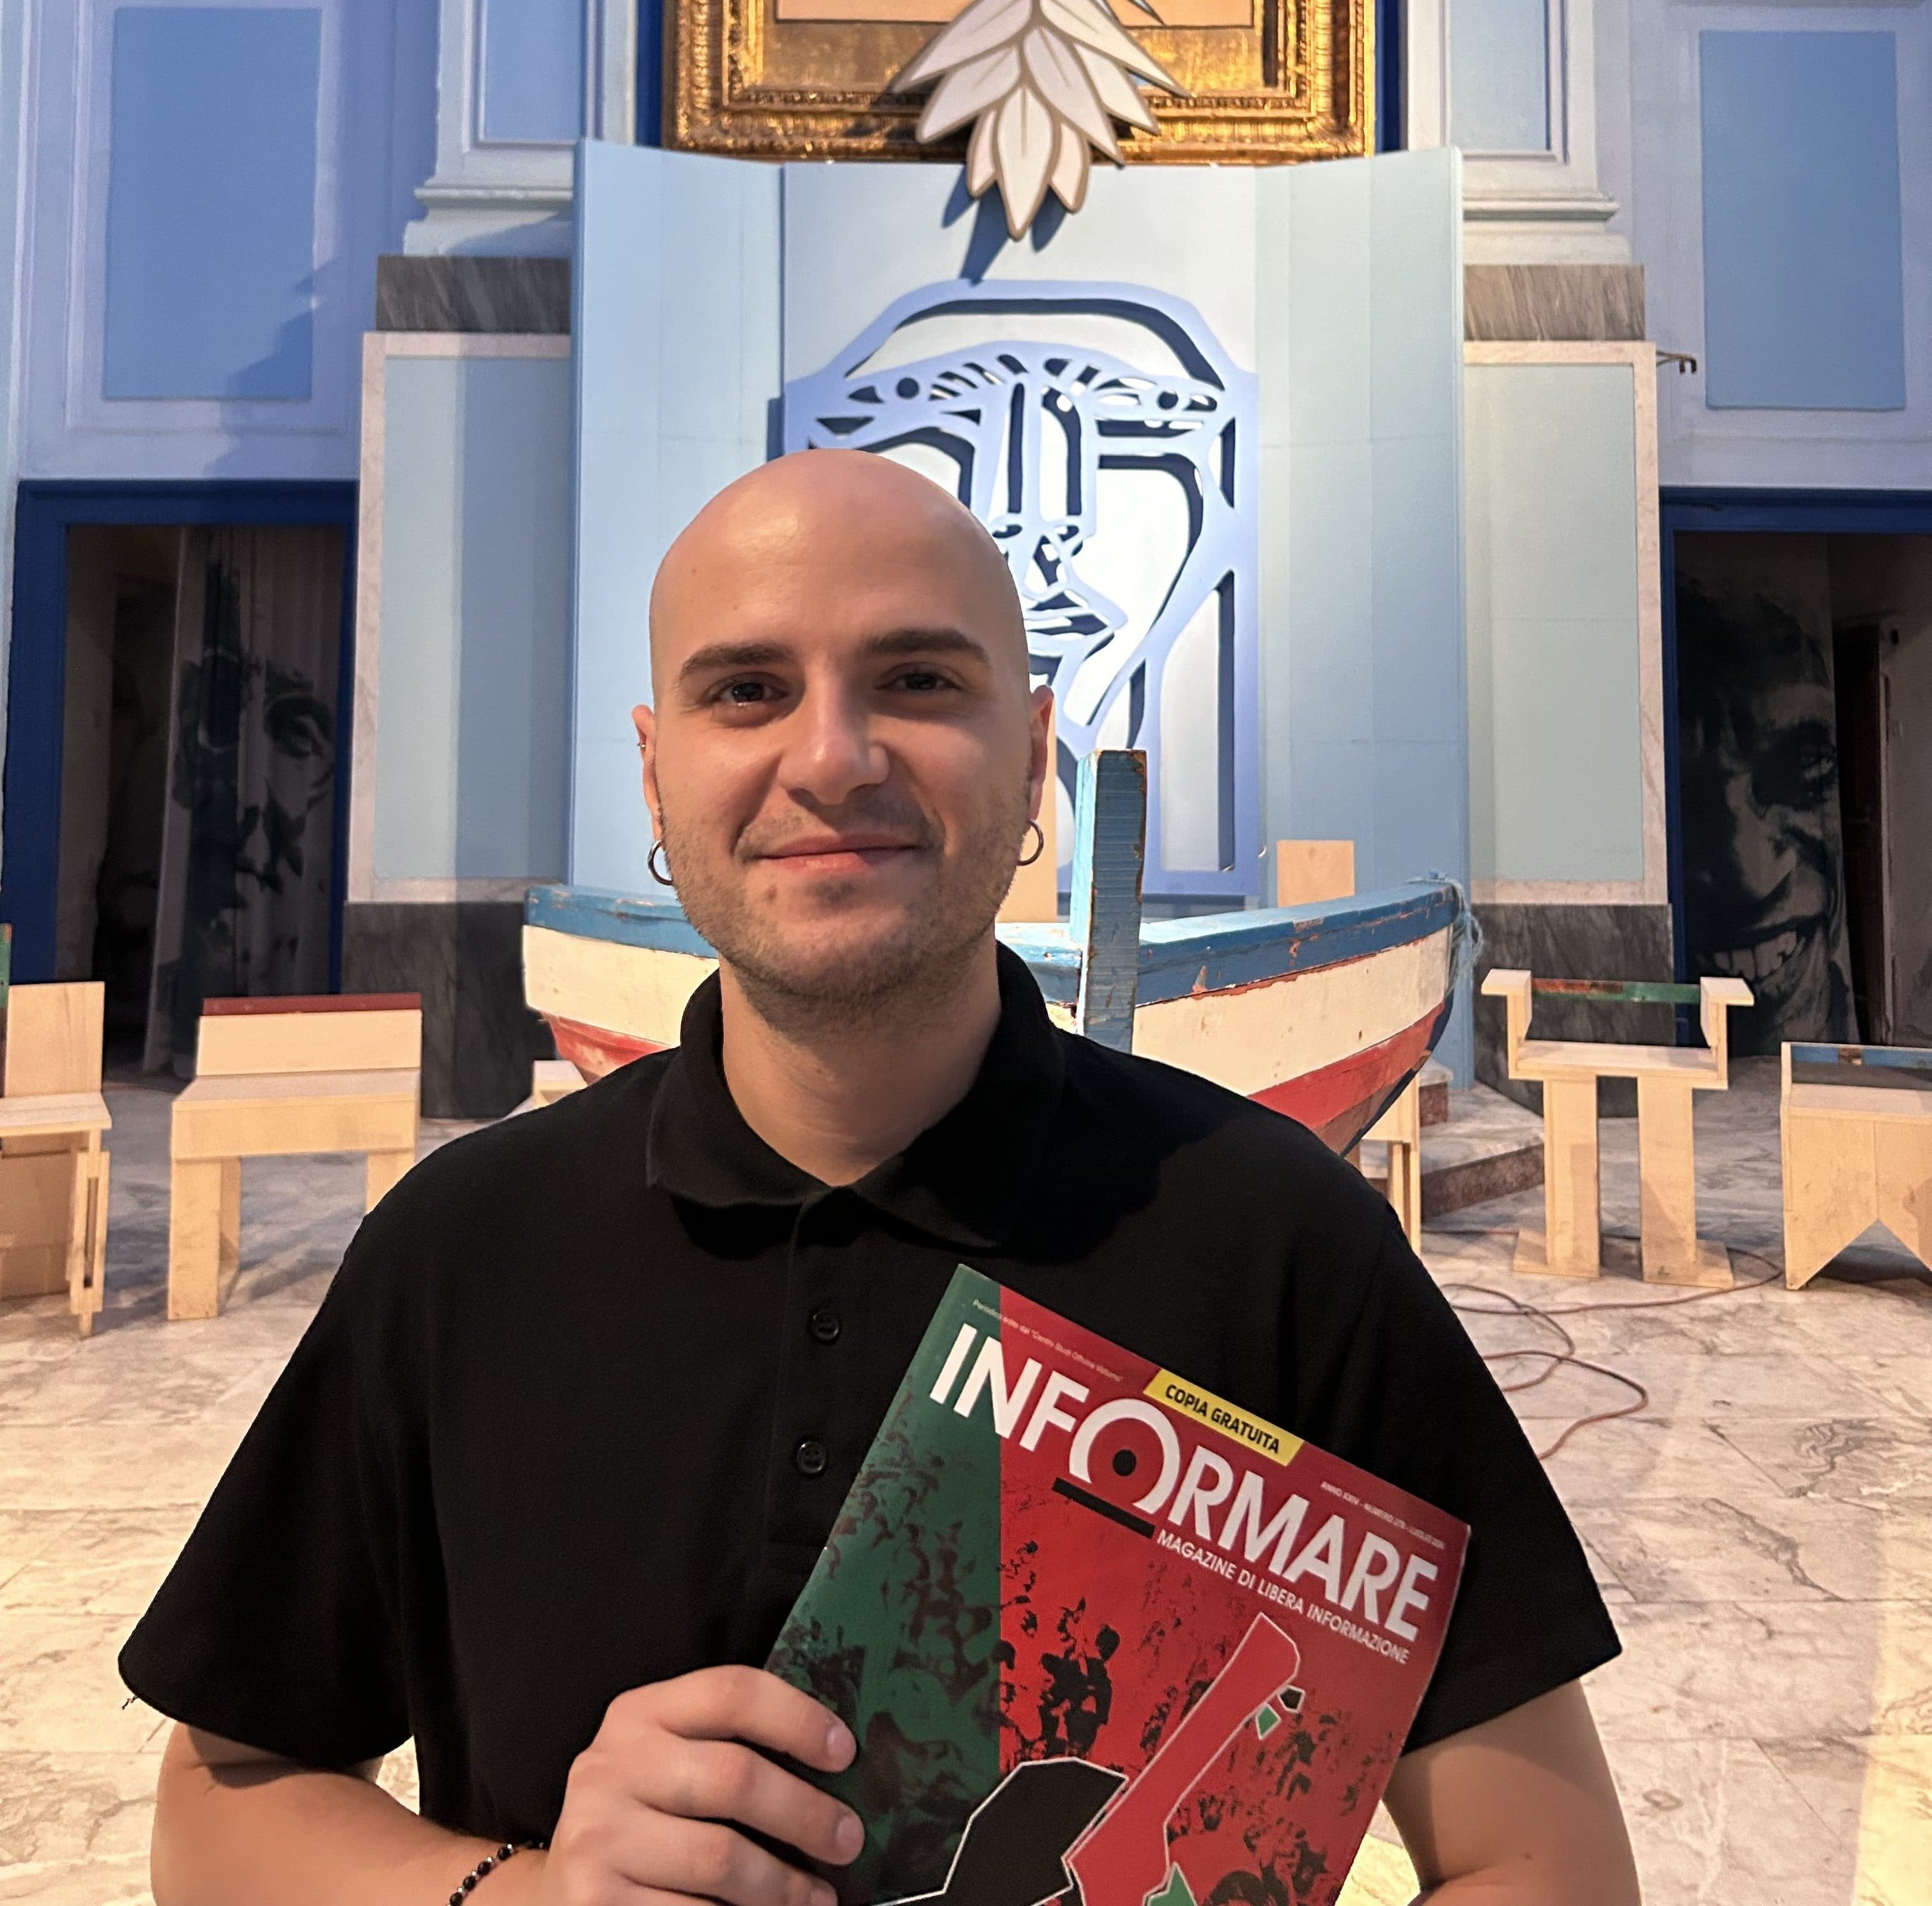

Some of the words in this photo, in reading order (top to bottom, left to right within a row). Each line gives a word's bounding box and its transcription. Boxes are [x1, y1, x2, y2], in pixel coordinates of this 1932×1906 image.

[930, 1323, 1438, 1643] INFORMARE
[1165, 1384, 1208, 1417] COPIA
[1211, 1408, 1280, 1454] GRATUITA
[1157, 1529, 1237, 1580] MAGAZINE
[1238, 1568, 1257, 1589] DI
[1257, 1579, 1303, 1614] LIBERA
[1307, 1603, 1411, 1665] INFORMAZIONE
